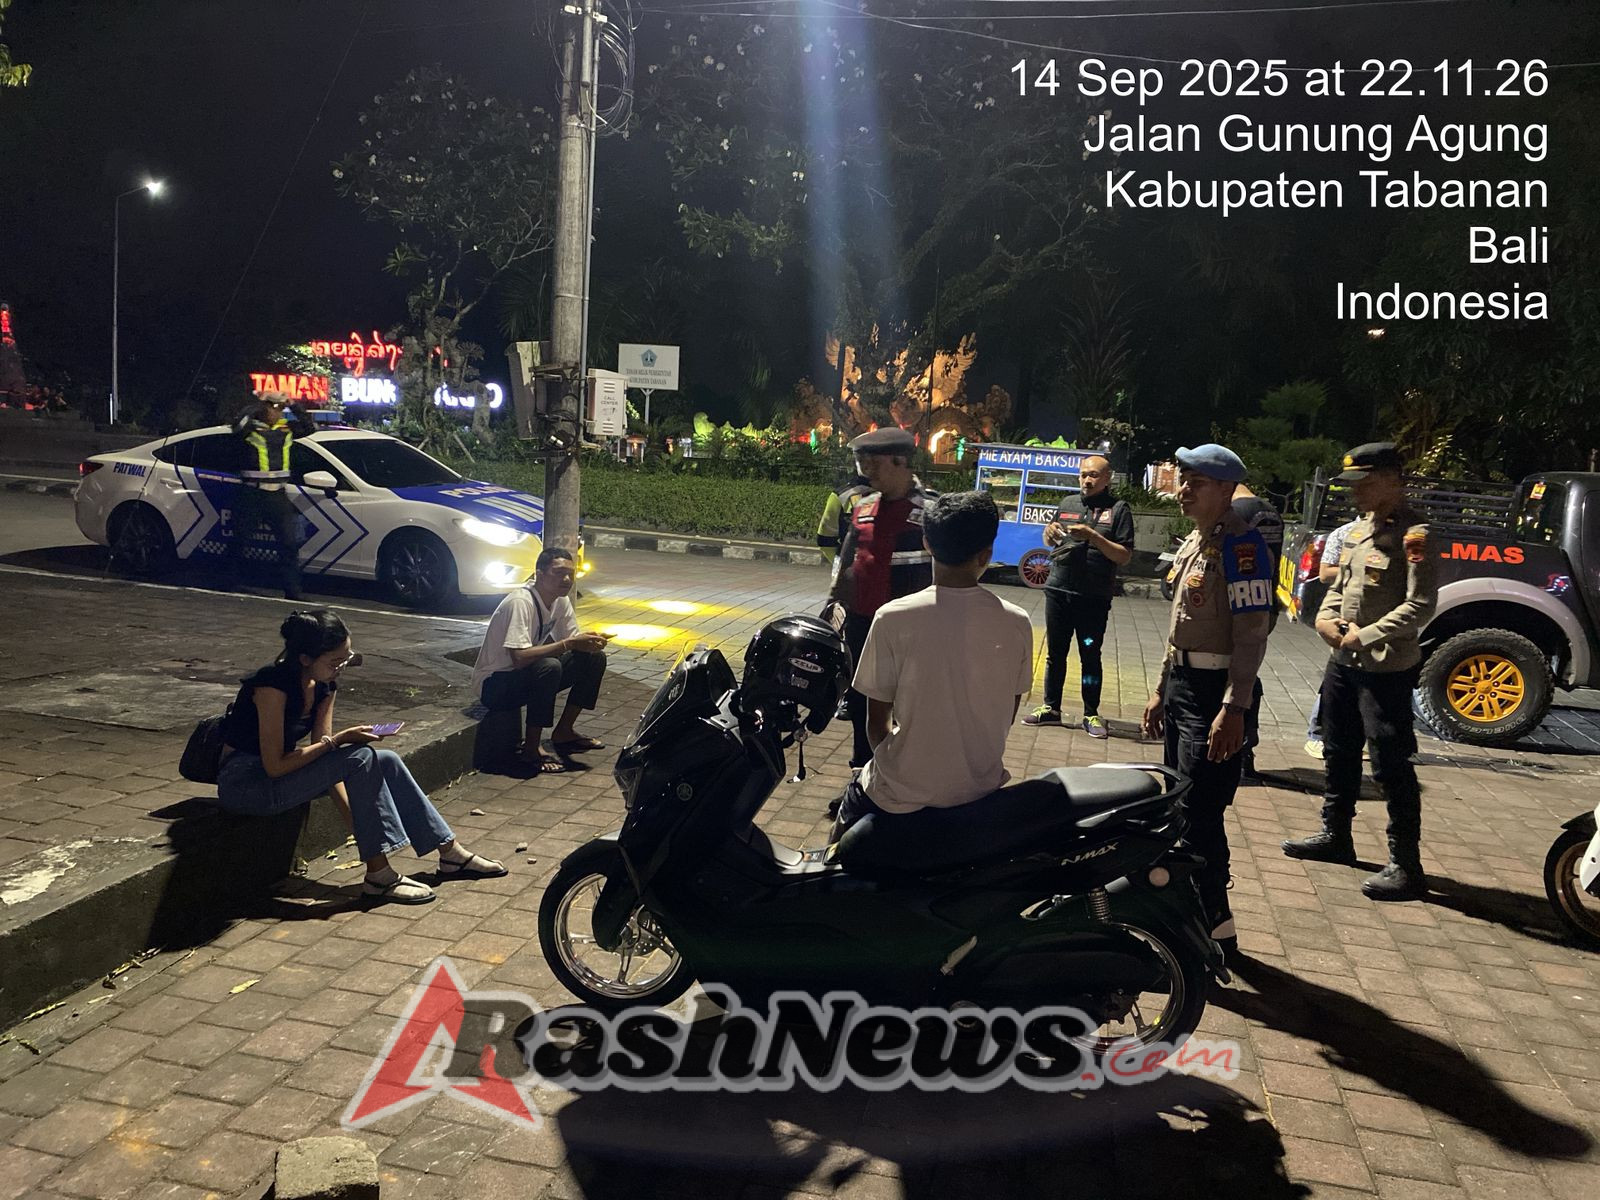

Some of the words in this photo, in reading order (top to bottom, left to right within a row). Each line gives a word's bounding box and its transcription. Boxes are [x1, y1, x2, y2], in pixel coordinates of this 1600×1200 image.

[250, 373, 328, 401] TAMAN
[980, 449, 998, 461] MIE
[1000, 450, 1032, 465] AYAM
[113, 462, 147, 477] PATWAL
[1024, 507, 1058, 522] BAKS
[794, 659, 819, 671] ZEUS
